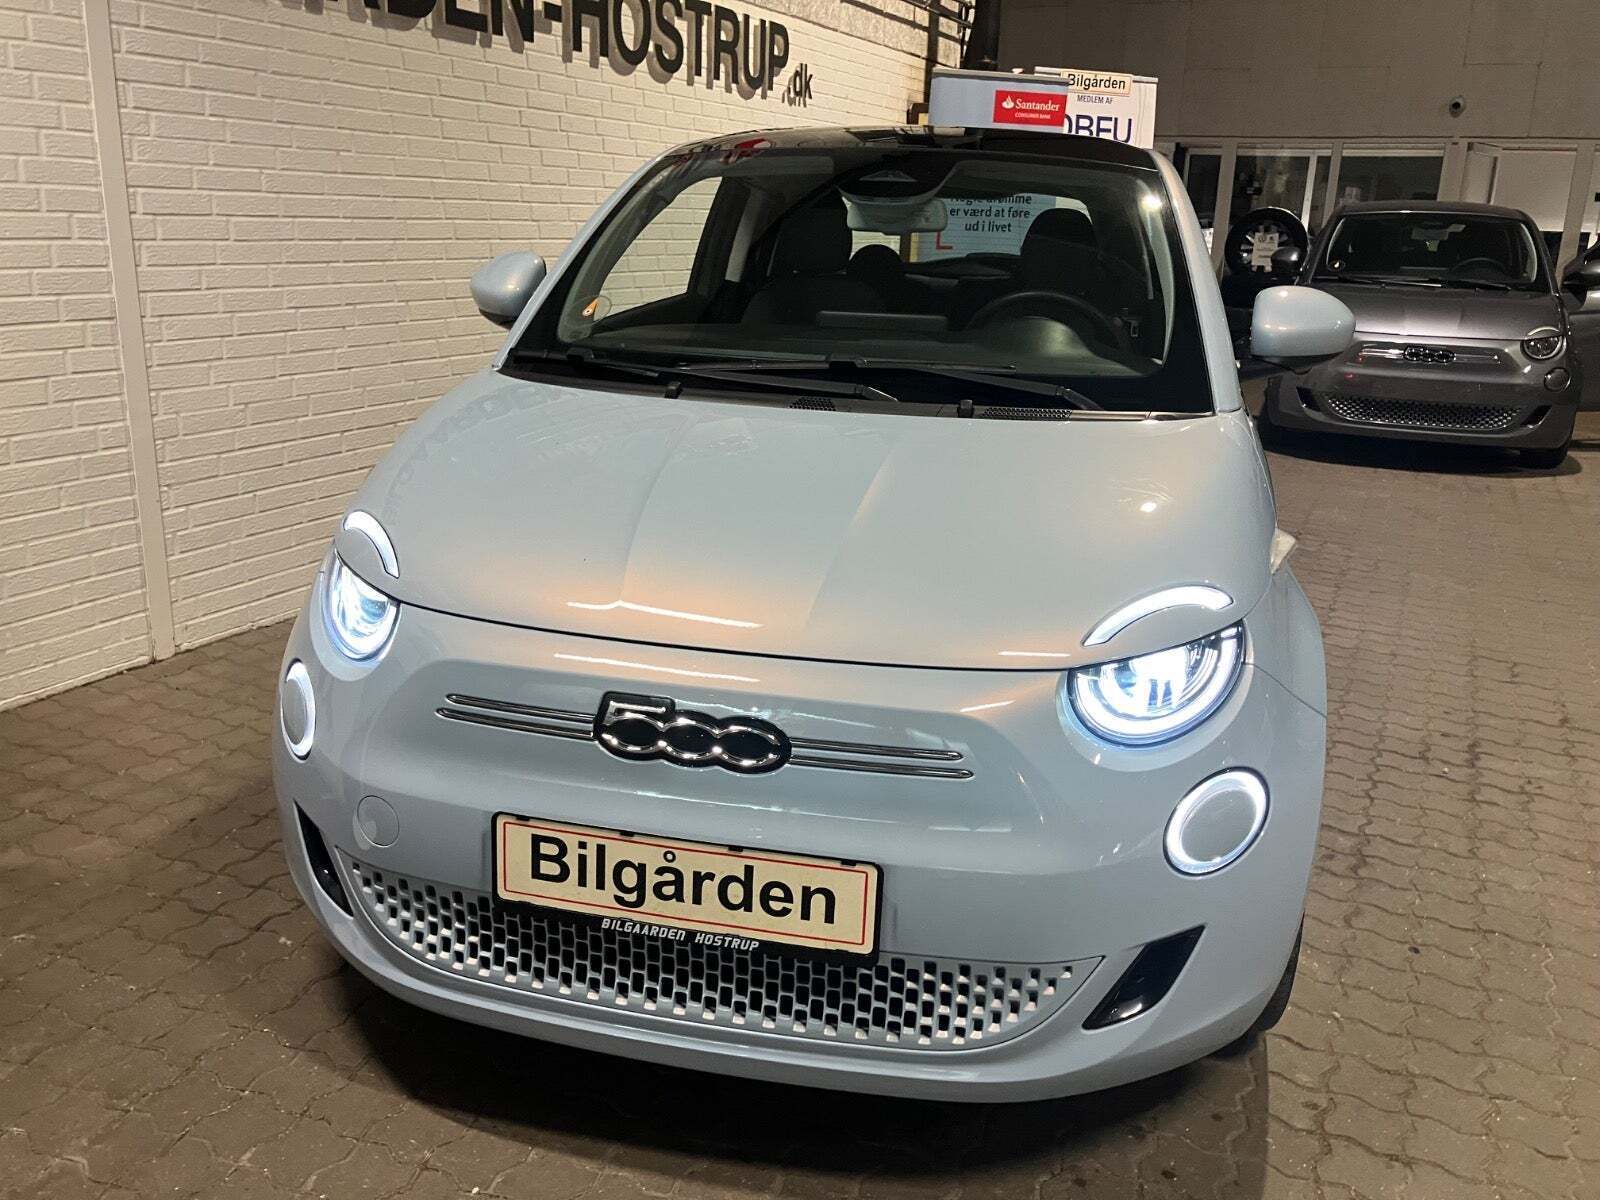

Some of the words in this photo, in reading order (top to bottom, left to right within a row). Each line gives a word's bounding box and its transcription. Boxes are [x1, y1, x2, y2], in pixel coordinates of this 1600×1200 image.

[1067, 73, 1126, 91] Bilgården
[1015, 98, 1060, 111] Santander
[1077, 95, 1104, 104] MEDLEM
[949, 208, 960, 216] er
[963, 206, 992, 217] værd
[994, 208, 1005, 217] at
[1007, 207, 1031, 218] føre
[964, 221, 979, 231] ud
[988, 221, 1012, 232] livet
[595, 693, 789, 772] 500
[530, 833, 836, 925] Bilgården
[601, 918, 686, 941] BILGAARDEN
[694, 933, 760, 951] HOSTRUP
